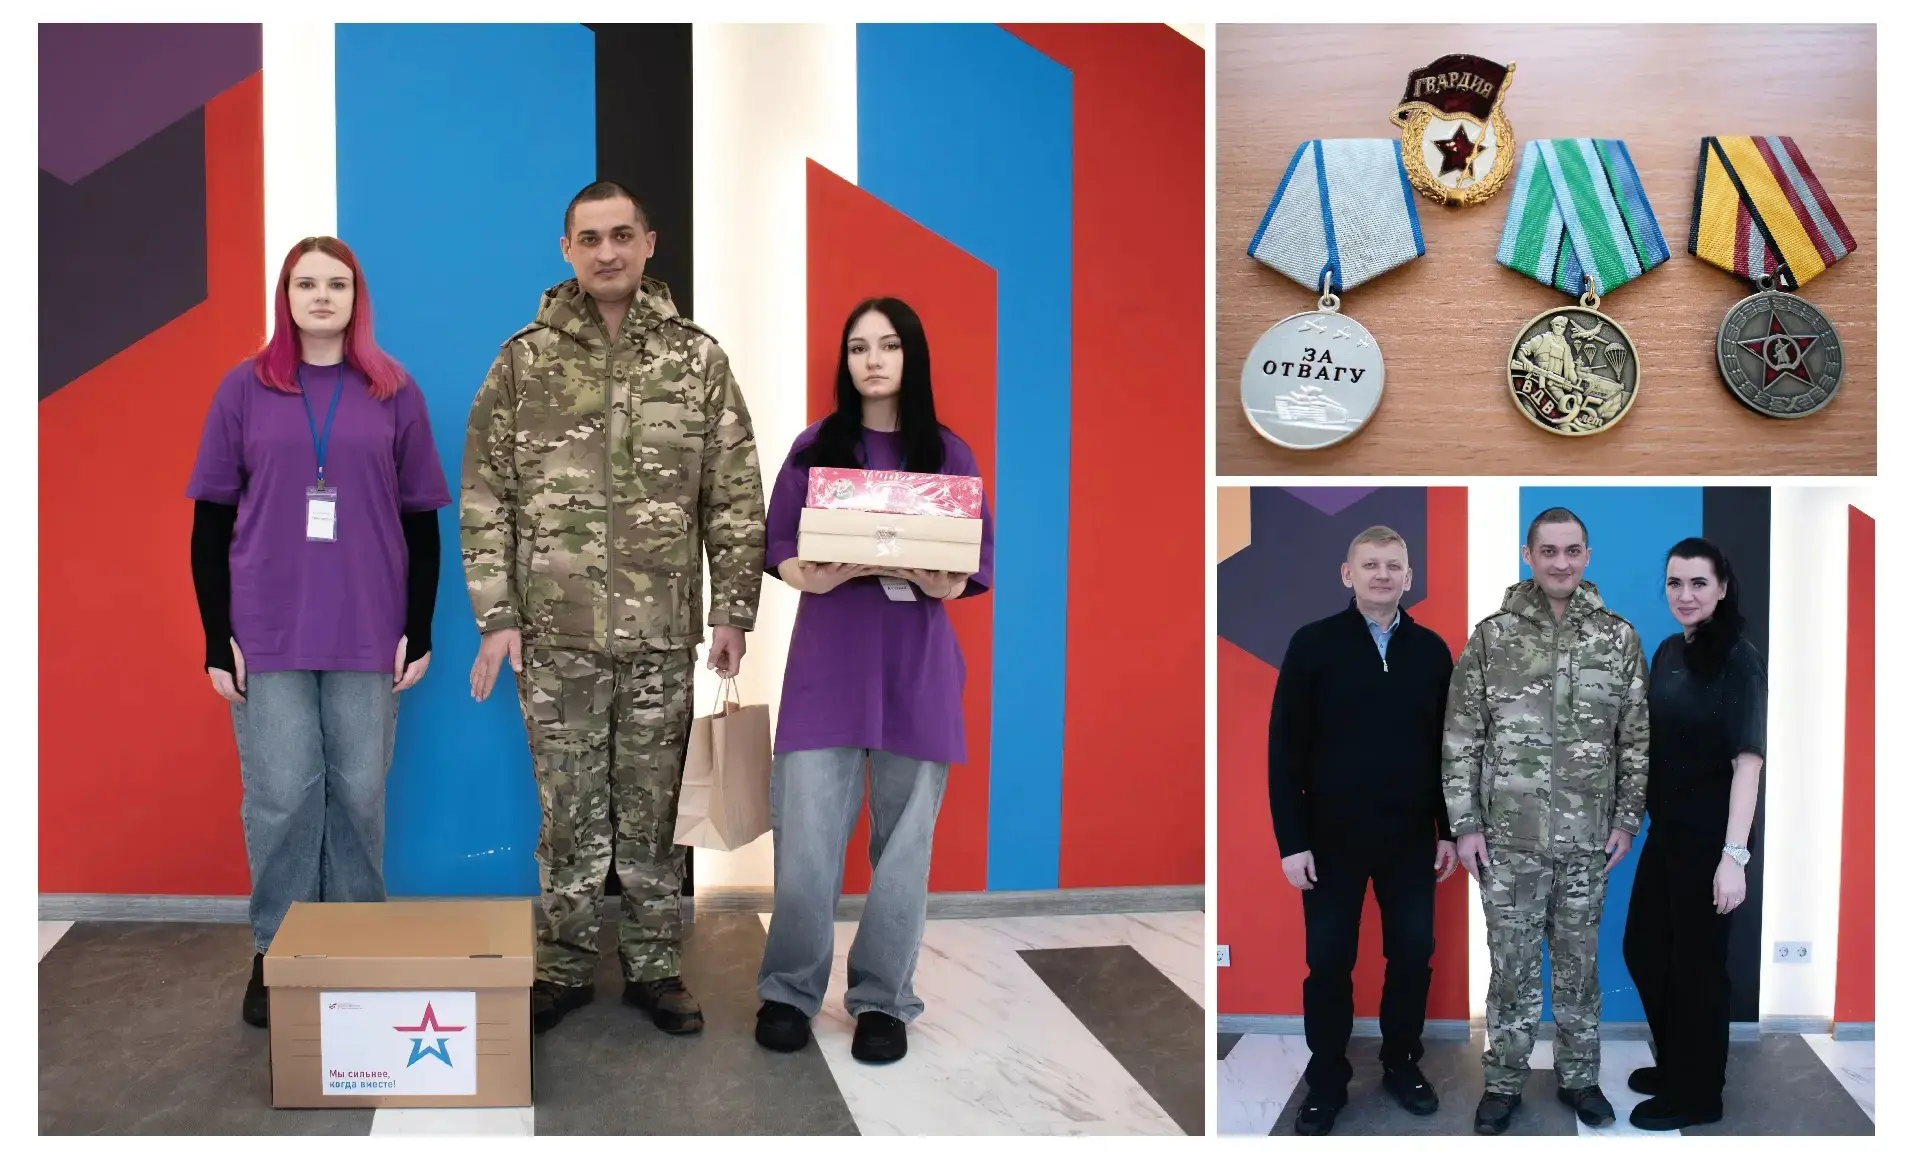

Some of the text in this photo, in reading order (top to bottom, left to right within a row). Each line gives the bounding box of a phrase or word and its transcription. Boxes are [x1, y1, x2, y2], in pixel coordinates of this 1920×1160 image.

[1413, 71, 1496, 98] ГВАРДИЯ
[1302, 347, 1333, 364] ЗА
[1262, 360, 1366, 383] ОТВАГУ
[1522, 379, 1555, 415] ВДВ
[1551, 394, 1604, 428] 95
[329, 1069, 391, 1079] Мы сильнее,
[329, 1079, 396, 1090] когда вместе!
